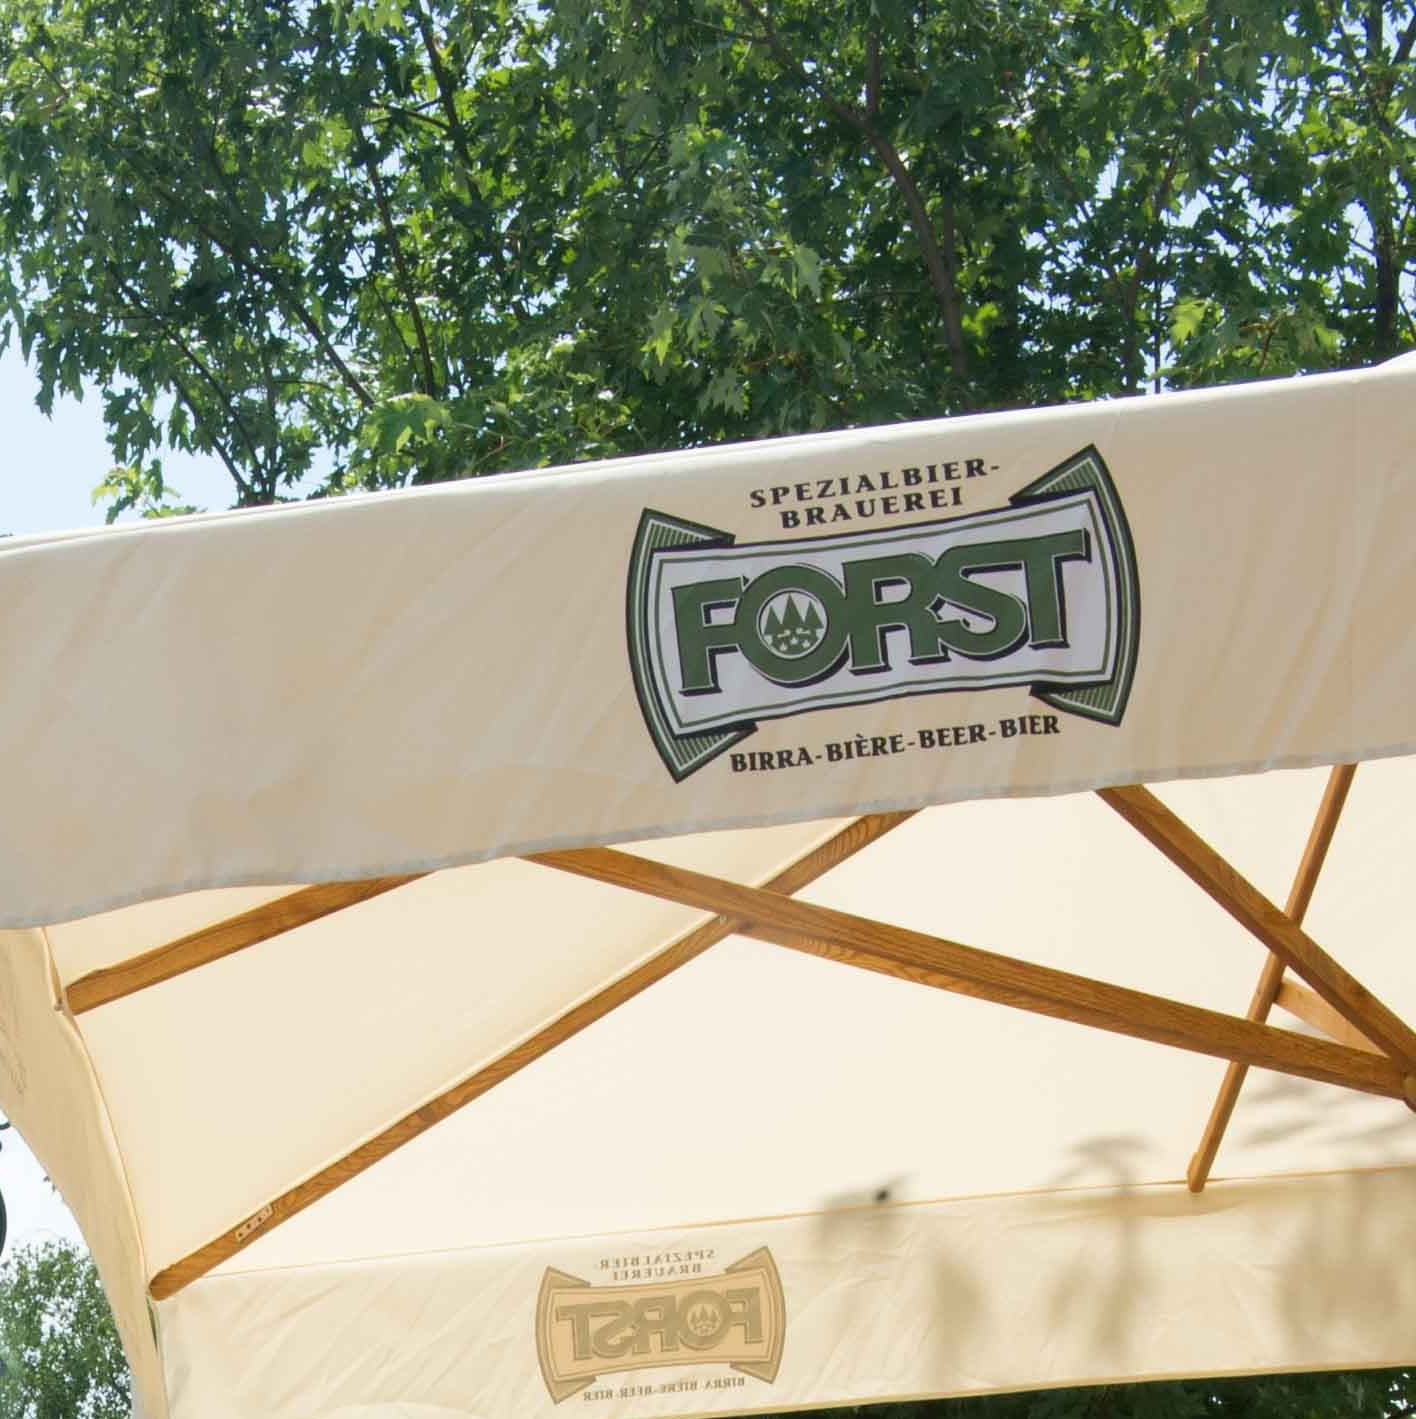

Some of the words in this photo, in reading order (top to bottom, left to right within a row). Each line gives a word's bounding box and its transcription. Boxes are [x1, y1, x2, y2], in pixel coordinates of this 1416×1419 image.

[749, 457, 1000, 509] SPEZIALBIER-
[781, 486, 964, 529] BRAUEREI
[671, 528, 1092, 696] FORST
